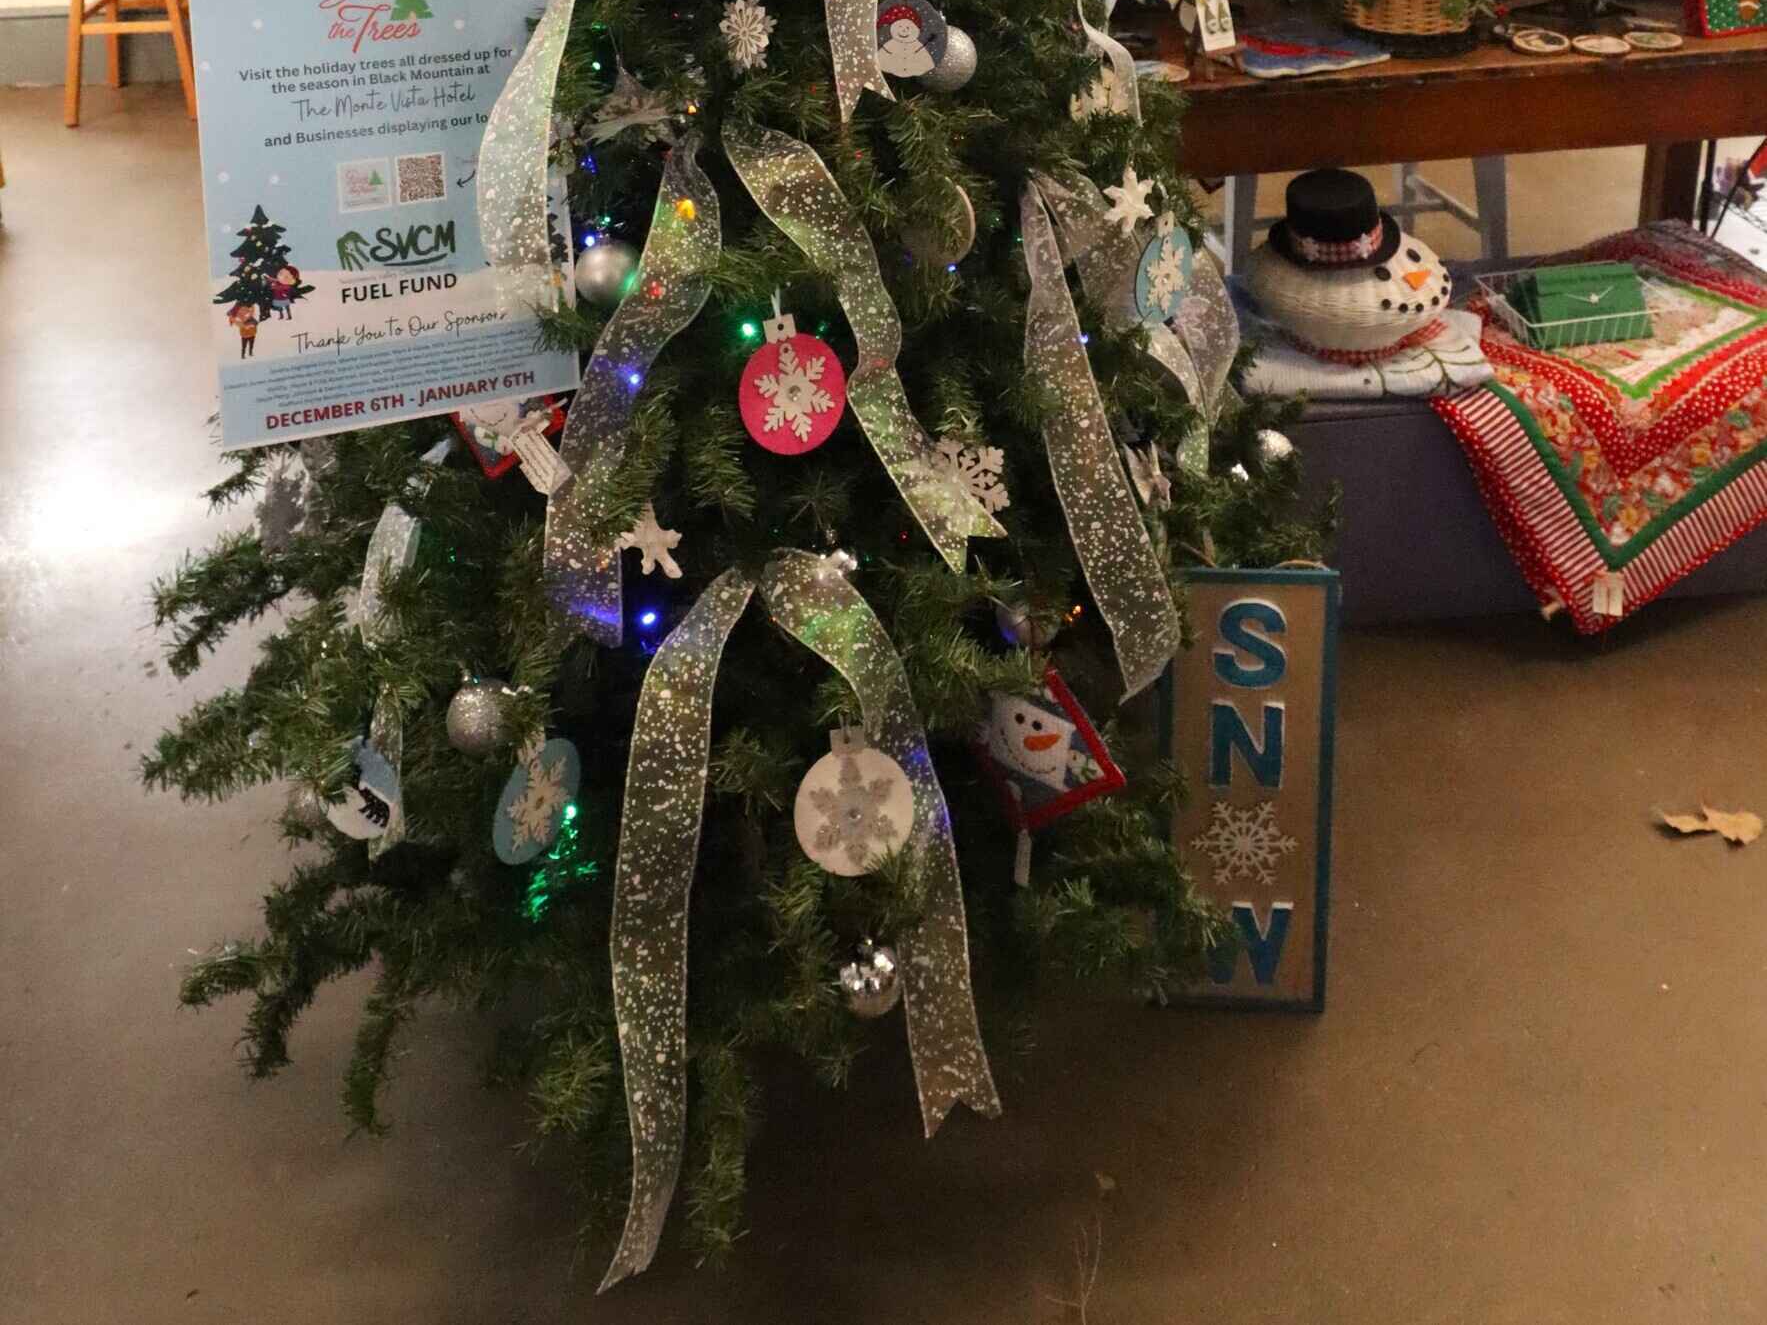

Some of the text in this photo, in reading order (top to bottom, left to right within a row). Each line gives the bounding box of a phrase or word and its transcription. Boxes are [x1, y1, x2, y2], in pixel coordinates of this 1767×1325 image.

[328, 3, 421, 54] the Trees
[239, 47, 513, 82] Visit the holiday trees all dressed up for
[272, 64, 490, 94] the season in Black Mountain at
[291, 81, 476, 122] The Monte Vista Hotel
[264, 132, 292, 147] and
[296, 126, 374, 144] Businesses
[377, 118, 448, 136] displaying
[451, 115, 473, 127] our
[369, 220, 456, 262] SVCM
[341, 282, 392, 304] FUEL
[400, 273, 457, 295] FUND
[291, 326, 350, 355] Thank
[354, 323, 386, 346] You
[408, 315, 438, 337] Our
[266, 400, 366, 430] DECEMBER
[370, 393, 405, 412] 6TH
[418, 377, 499, 407] JANUARY
[503, 371, 535, 389] 6TH
